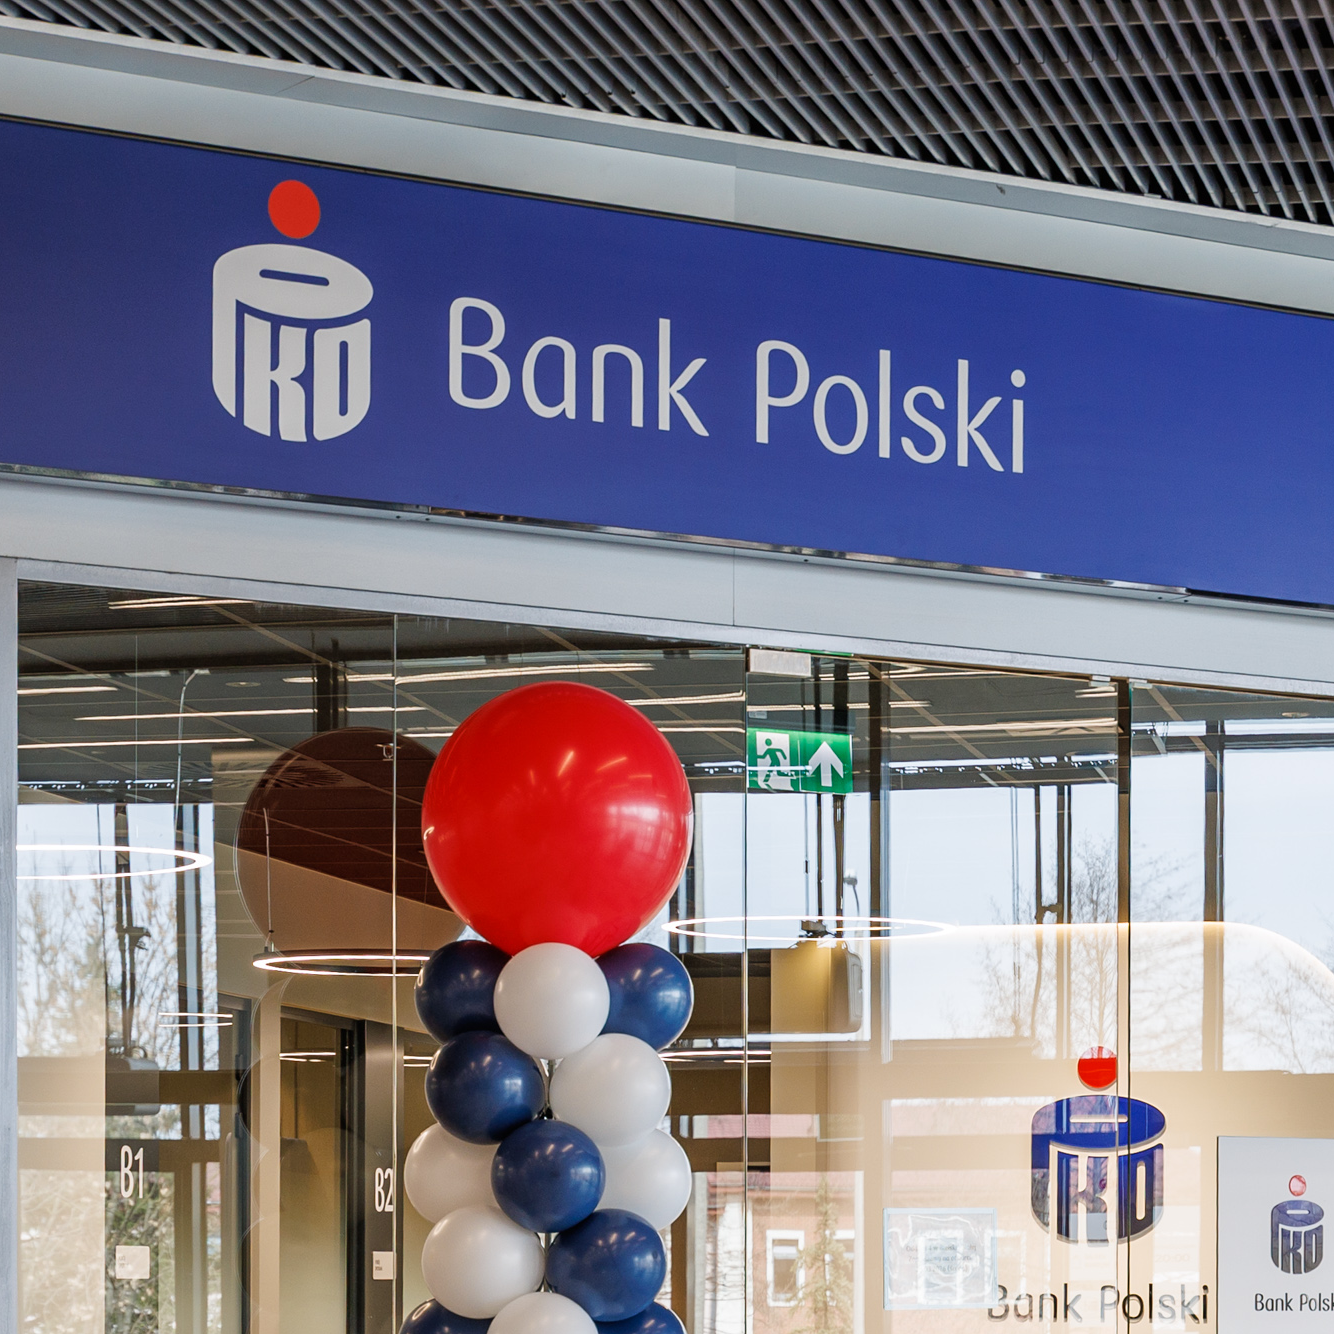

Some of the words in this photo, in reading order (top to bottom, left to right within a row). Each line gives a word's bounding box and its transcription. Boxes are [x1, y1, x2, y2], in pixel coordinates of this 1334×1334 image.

[450, 297, 709, 437] Bank
[756, 340, 1026, 474] Polski
[120, 1144, 144, 1199] B1
[375, 1167, 394, 1213] B2
[986, 1283, 1083, 1324] Bank
[1100, 1283, 1209, 1325] Polski
[1254, 1292, 1294, 1312] Bank
